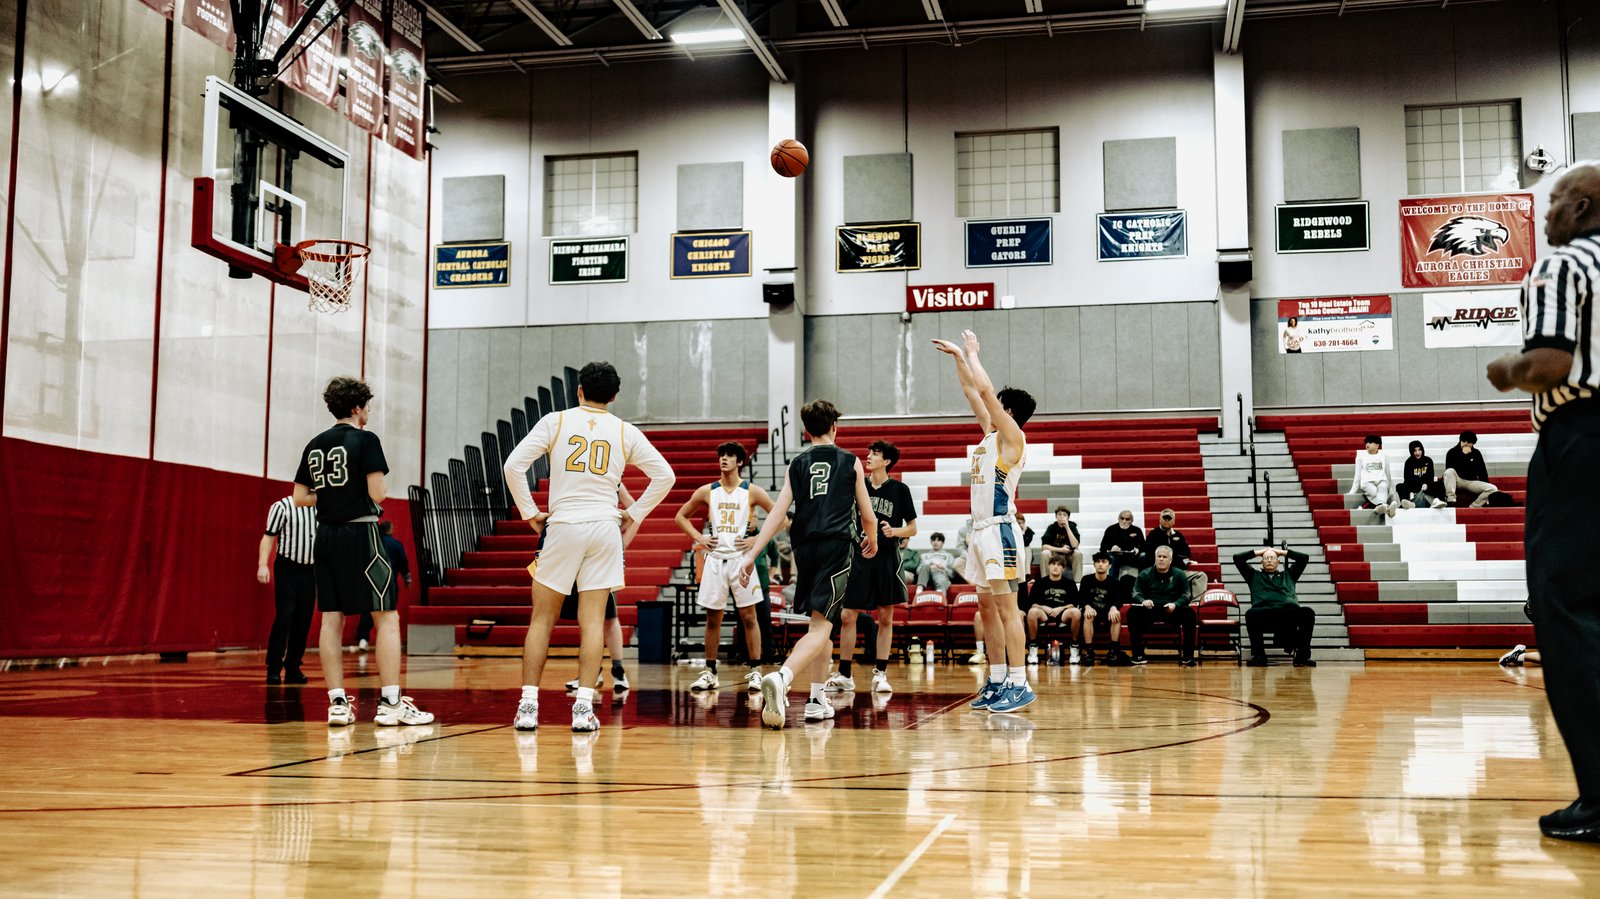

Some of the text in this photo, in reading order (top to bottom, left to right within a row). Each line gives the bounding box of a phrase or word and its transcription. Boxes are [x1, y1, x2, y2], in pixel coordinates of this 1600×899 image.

[196, 6, 228, 33] FOOTBALL
[1402, 206, 1449, 216] WELCOME
[1451, 204, 1463, 213] TO
[1467, 203, 1485, 212] THE
[1489, 202, 1516, 211] HOME
[1126, 218, 1171, 229] CATHOLIC
[1293, 215, 1353, 228] RIDGEWOOD
[990, 225, 1027, 236] GUERIN
[1129, 231, 1155, 241] PREP
[1303, 229, 1343, 240] REBELS
[692, 238, 730, 248] CHICAGO
[996, 238, 1021, 248] PREP
[1121, 242, 1164, 253] KNIGHTS
[455, 249, 489, 259] AURORA
[553, 245, 581, 254] BISHOP
[687, 249, 735, 260] CHRISTIAN
[571, 255, 609, 266] FIGHTING
[991, 251, 1027, 261] GATORS
[437, 260, 508, 271] CENTRAL CATHOLIC
[691, 262, 731, 272] KNIGHTS
[1416, 258, 1523, 272] AURORA CHRISTIAN
[578, 266, 602, 277] IRISH
[1448, 270, 1490, 282] EAGLES
[449, 272, 494, 283] CHARGERS
[912, 287, 989, 309] Visitor
[1318, 300, 1333, 308] Real
[1305, 307, 1322, 315] Kane
[1453, 307, 1518, 321] RIDGE
[565, 434, 611, 475] 20
[308, 445, 349, 491] 23
[809, 461, 832, 499] 2
[720, 510, 736, 525] 34
